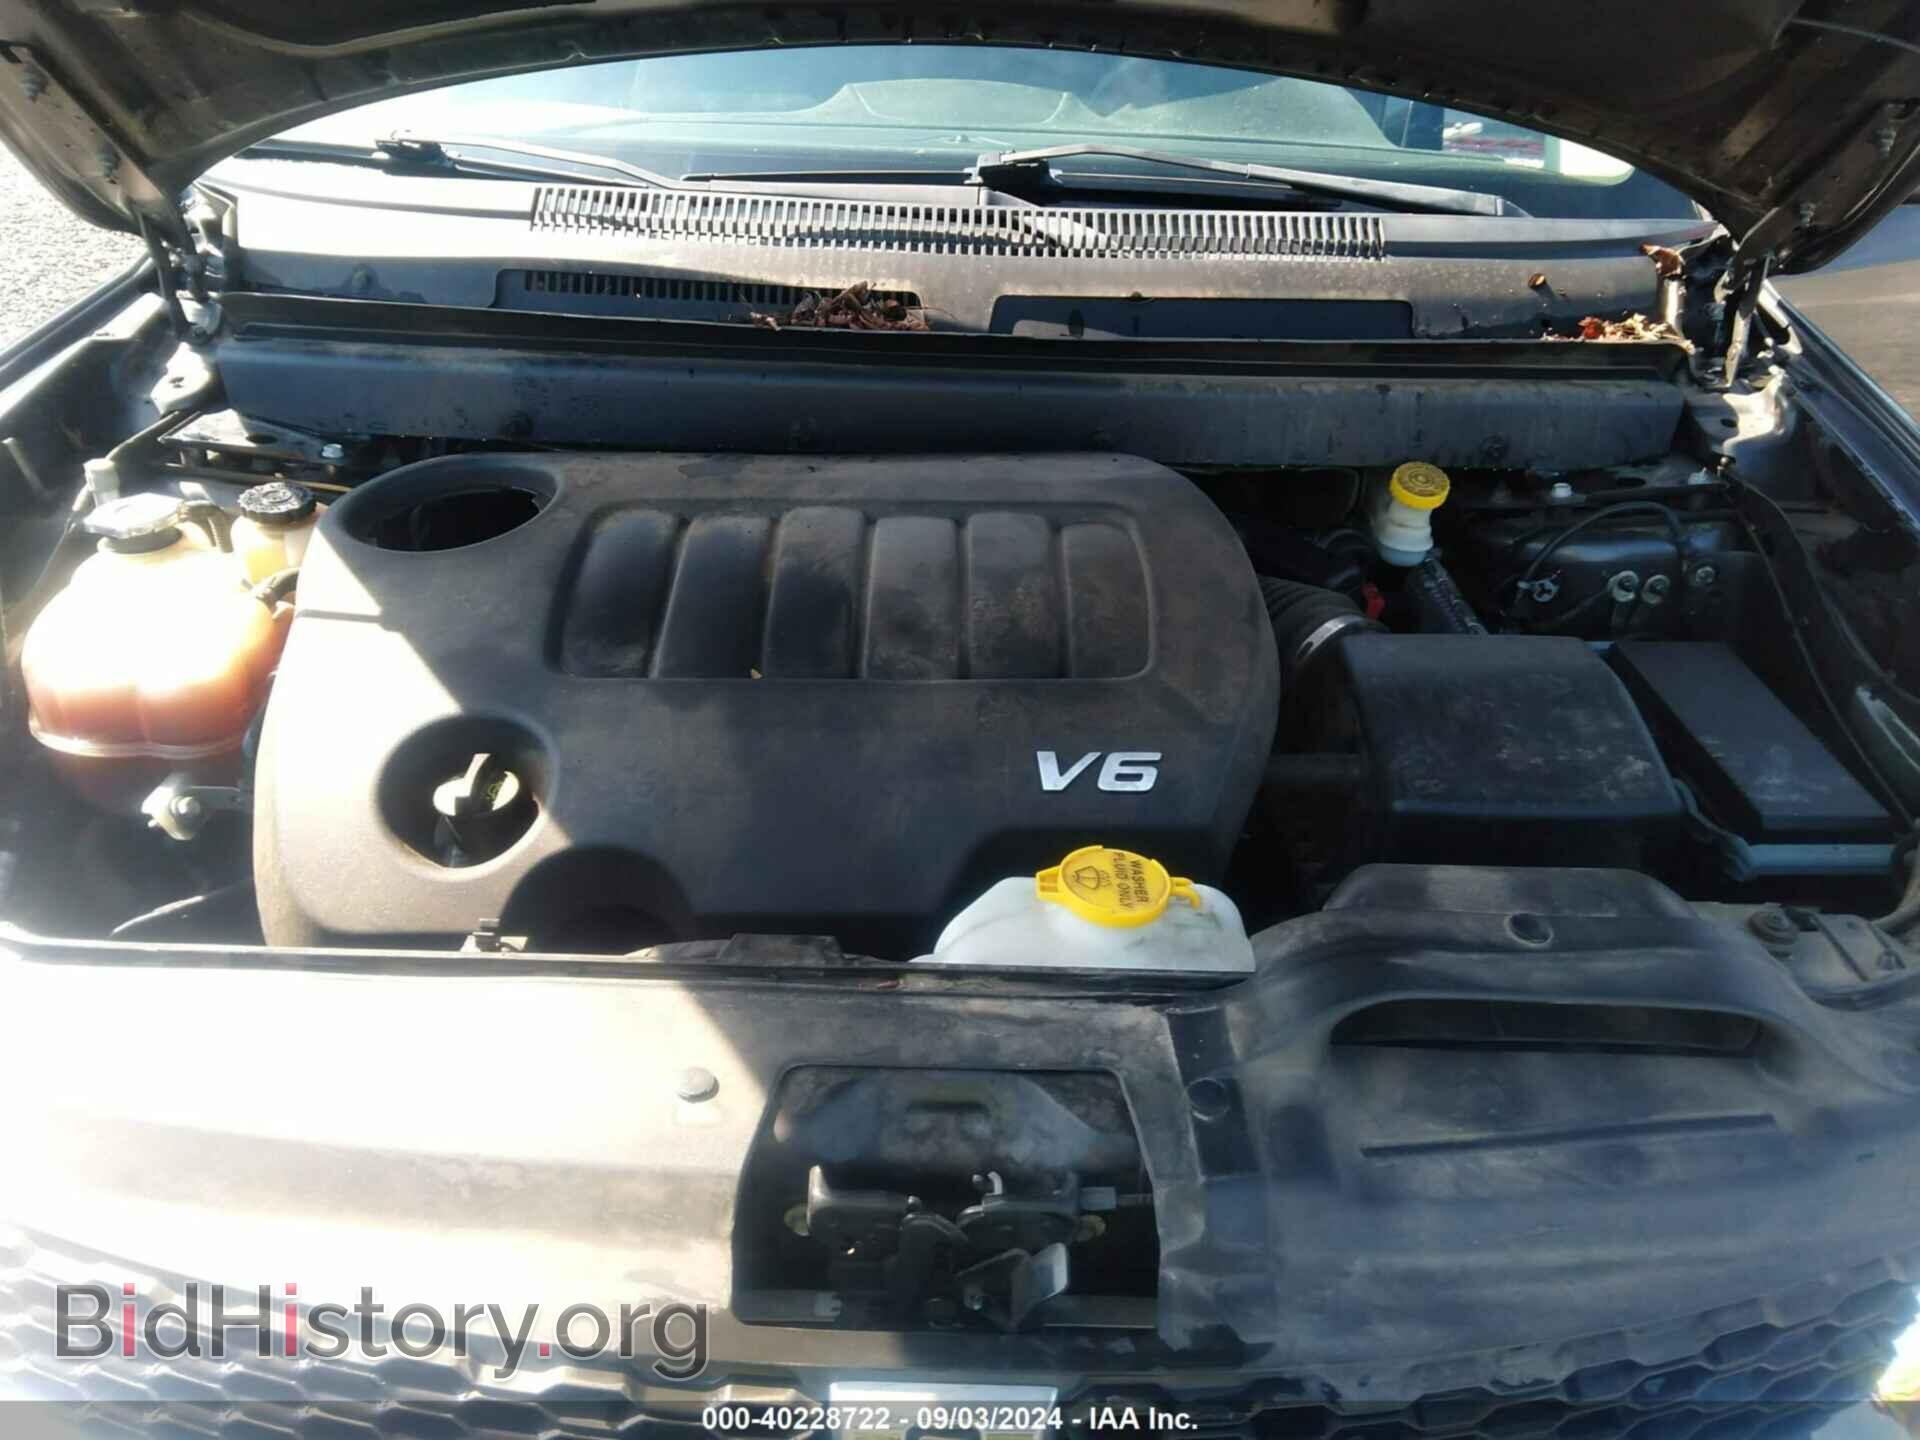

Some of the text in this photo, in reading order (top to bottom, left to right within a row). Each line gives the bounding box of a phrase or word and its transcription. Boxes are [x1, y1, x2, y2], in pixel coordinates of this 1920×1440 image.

[1036, 751, 1162, 791] V6
[1111, 851, 1134, 910] FLUID ONLY
[1129, 859, 1149, 903] WASHER
